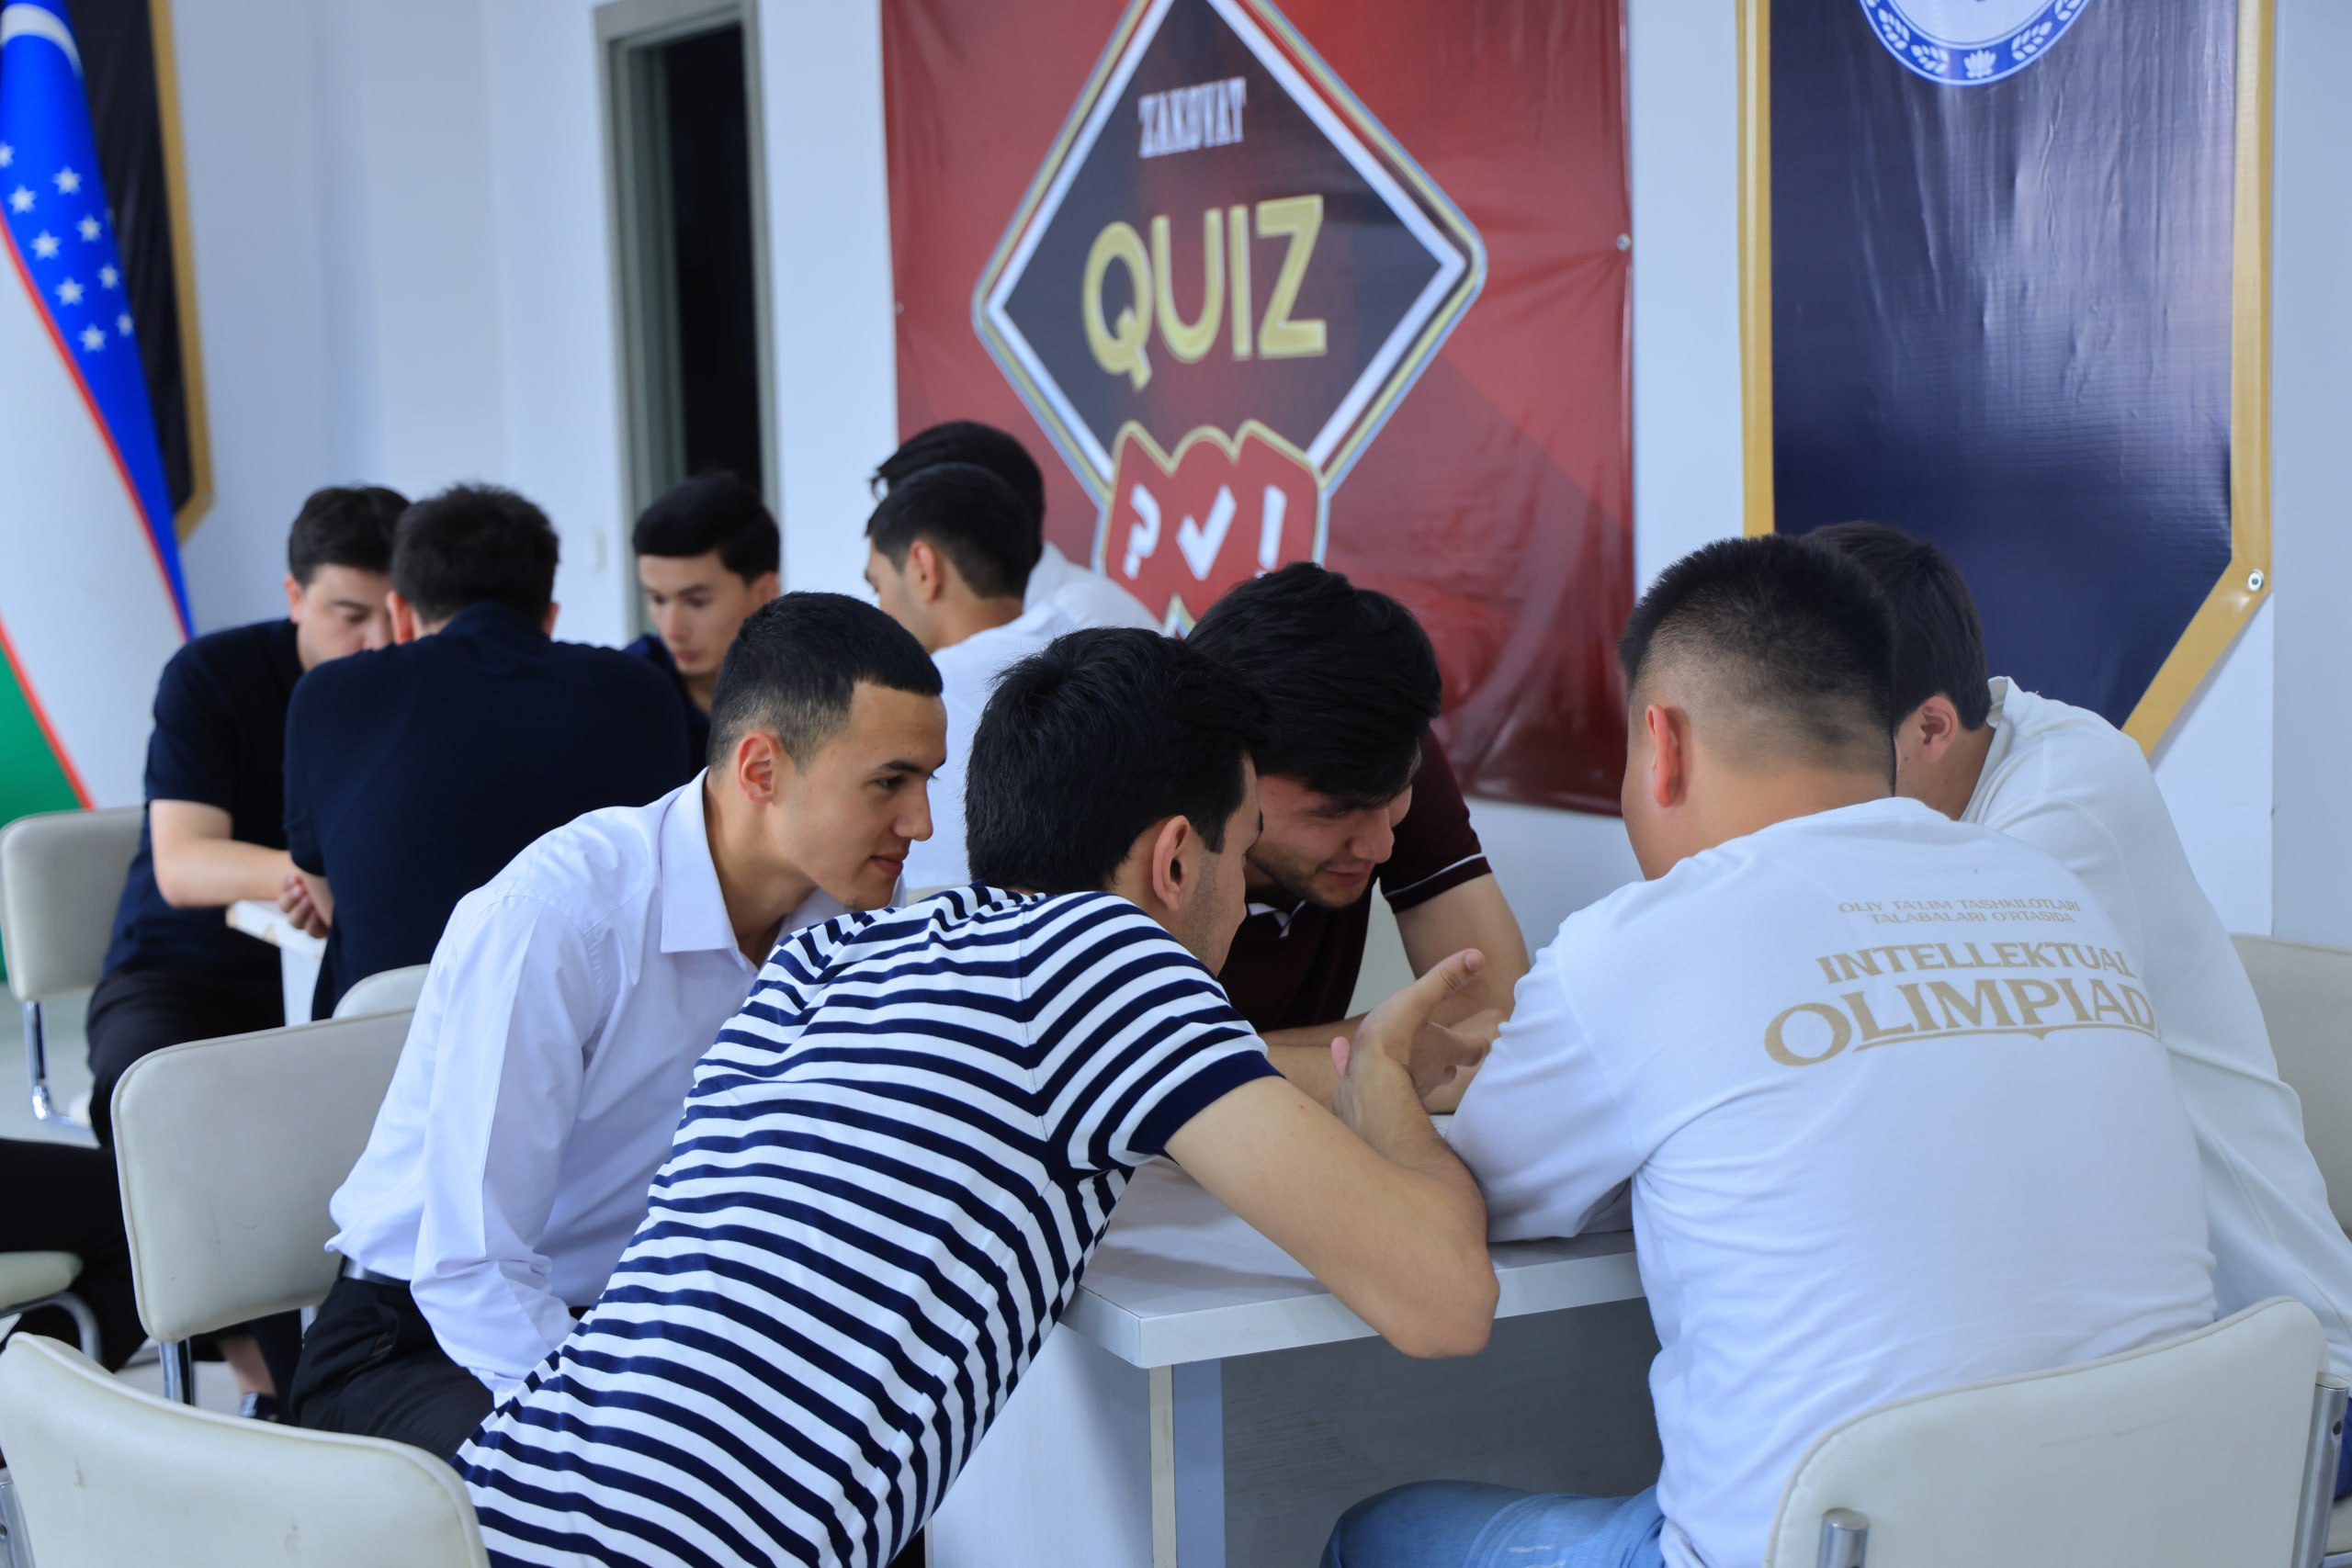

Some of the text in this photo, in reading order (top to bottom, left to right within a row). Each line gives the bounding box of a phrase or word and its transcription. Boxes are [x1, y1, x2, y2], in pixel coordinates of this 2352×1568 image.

[1138, 76, 1247, 158] ZAKOVAT
[1081, 194, 1328, 392] QUIZ
[1838, 902, 1883, 914] OLIY
[1867, 912, 1987, 924] TALABALARI
[1815, 942, 2137, 984] INTELLEKTUAL
[1764, 977, 2162, 1066] OLIMPIAD
